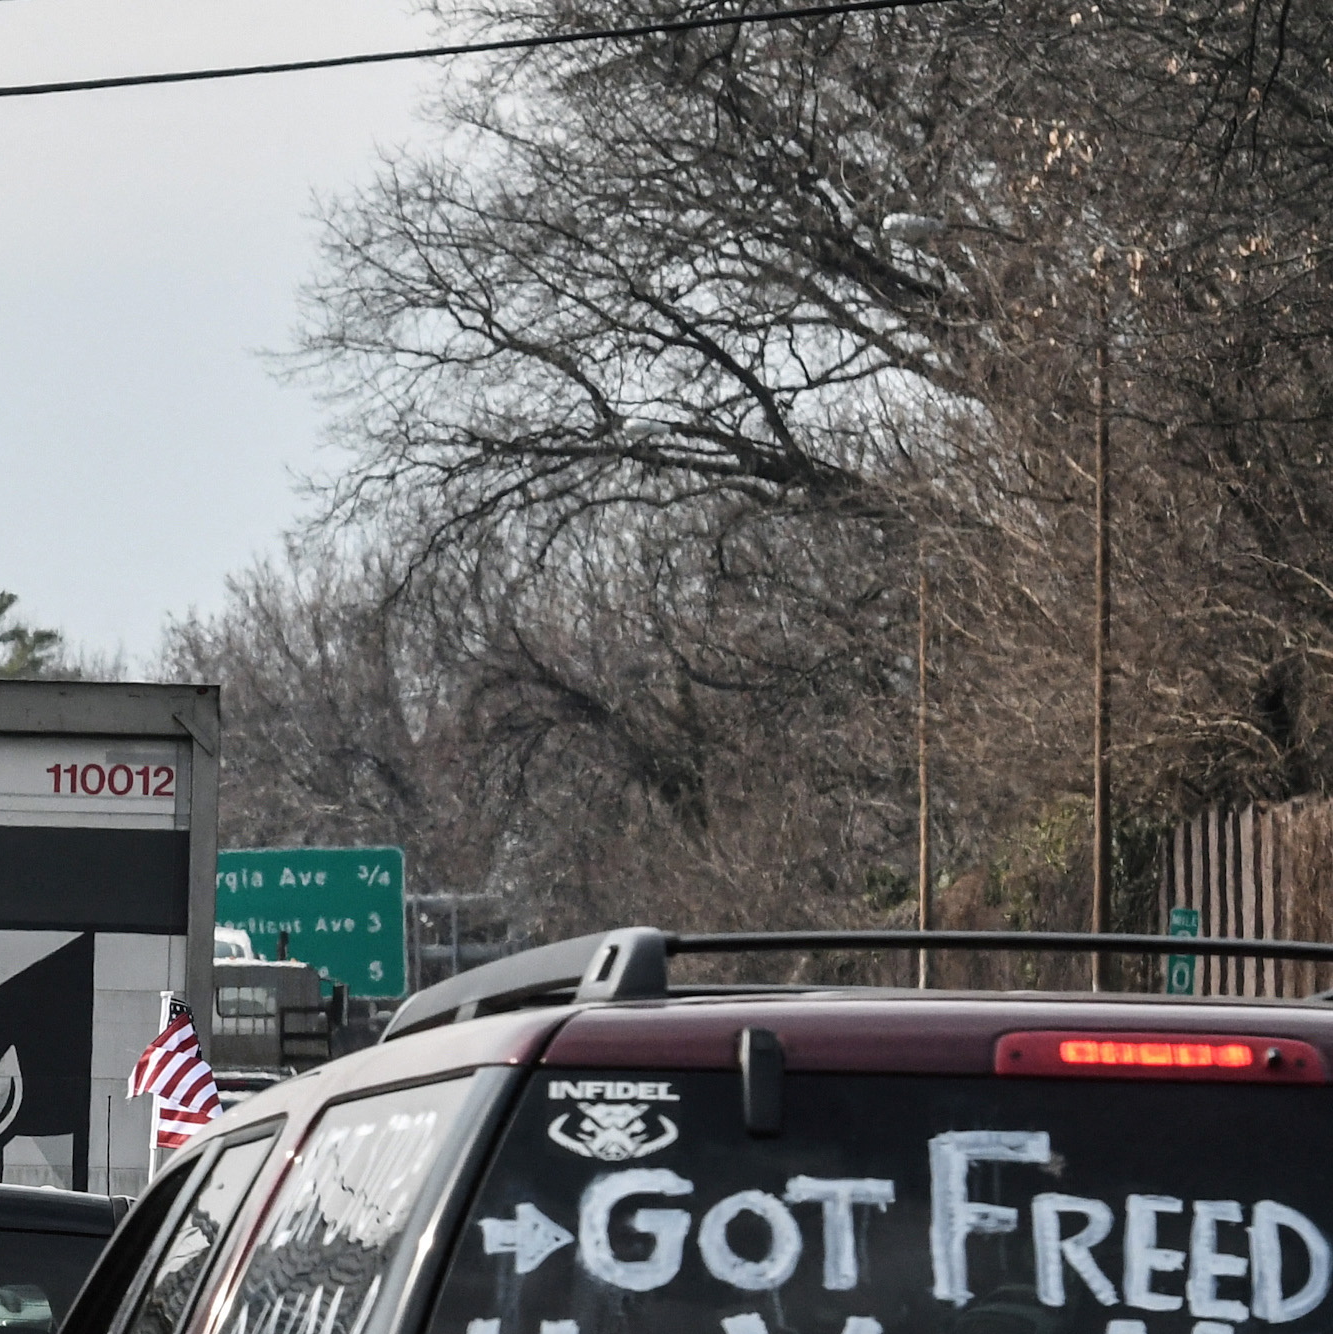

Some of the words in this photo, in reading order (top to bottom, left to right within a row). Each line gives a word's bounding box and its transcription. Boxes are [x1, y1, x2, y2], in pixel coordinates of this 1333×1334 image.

[46, 763, 175, 796] 110012
[279, 867, 328, 888] Ave
[367, 911, 382, 934] 3
[548, 1081, 681, 1101] INFIDEL
[577, 1167, 895, 1291] GOT
